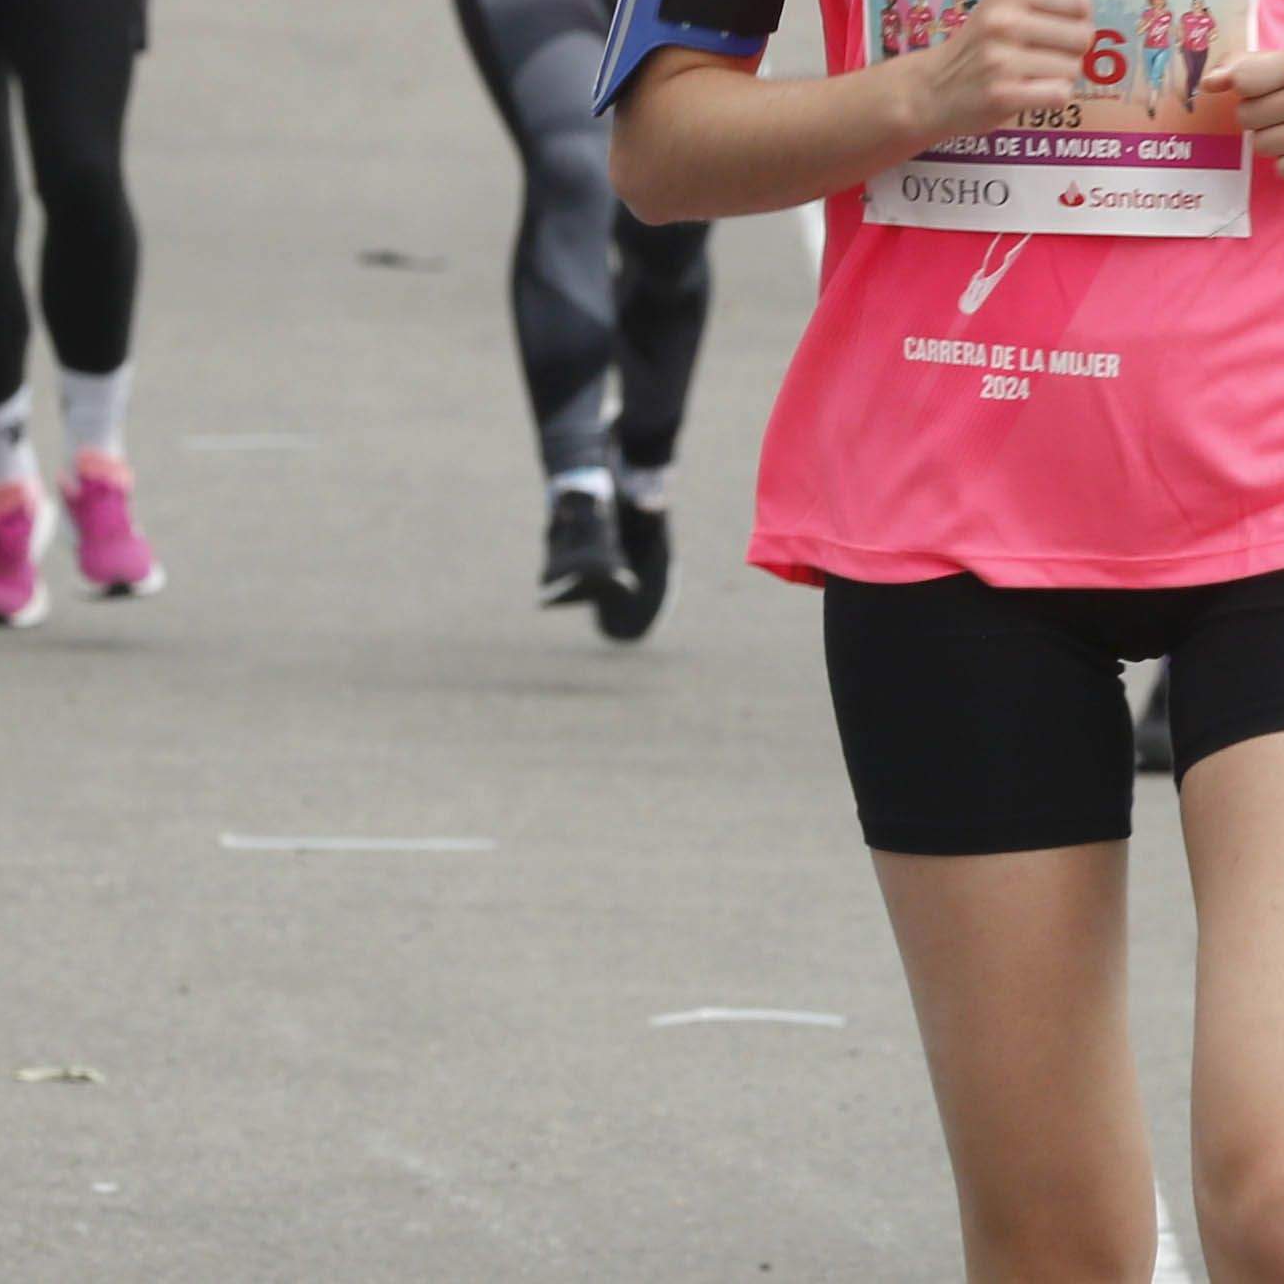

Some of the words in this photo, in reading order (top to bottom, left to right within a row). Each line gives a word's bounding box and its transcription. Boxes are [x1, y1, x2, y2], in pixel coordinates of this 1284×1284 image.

[1083, 28, 1127, 86] 6
[995, 136, 1022, 157] DE
[1025, 137, 1053, 157] LA
[1055, 138, 1122, 159] MUJER
[901, 174, 1010, 207] OYSHO
[1089, 186, 1204, 211] Santander
[903, 336, 988, 367] CARRERA
[990, 344, 1017, 371] DE
[1020, 347, 1045, 373] LA
[1049, 349, 1121, 378] MUJER
[979, 373, 1032, 401] 2024
